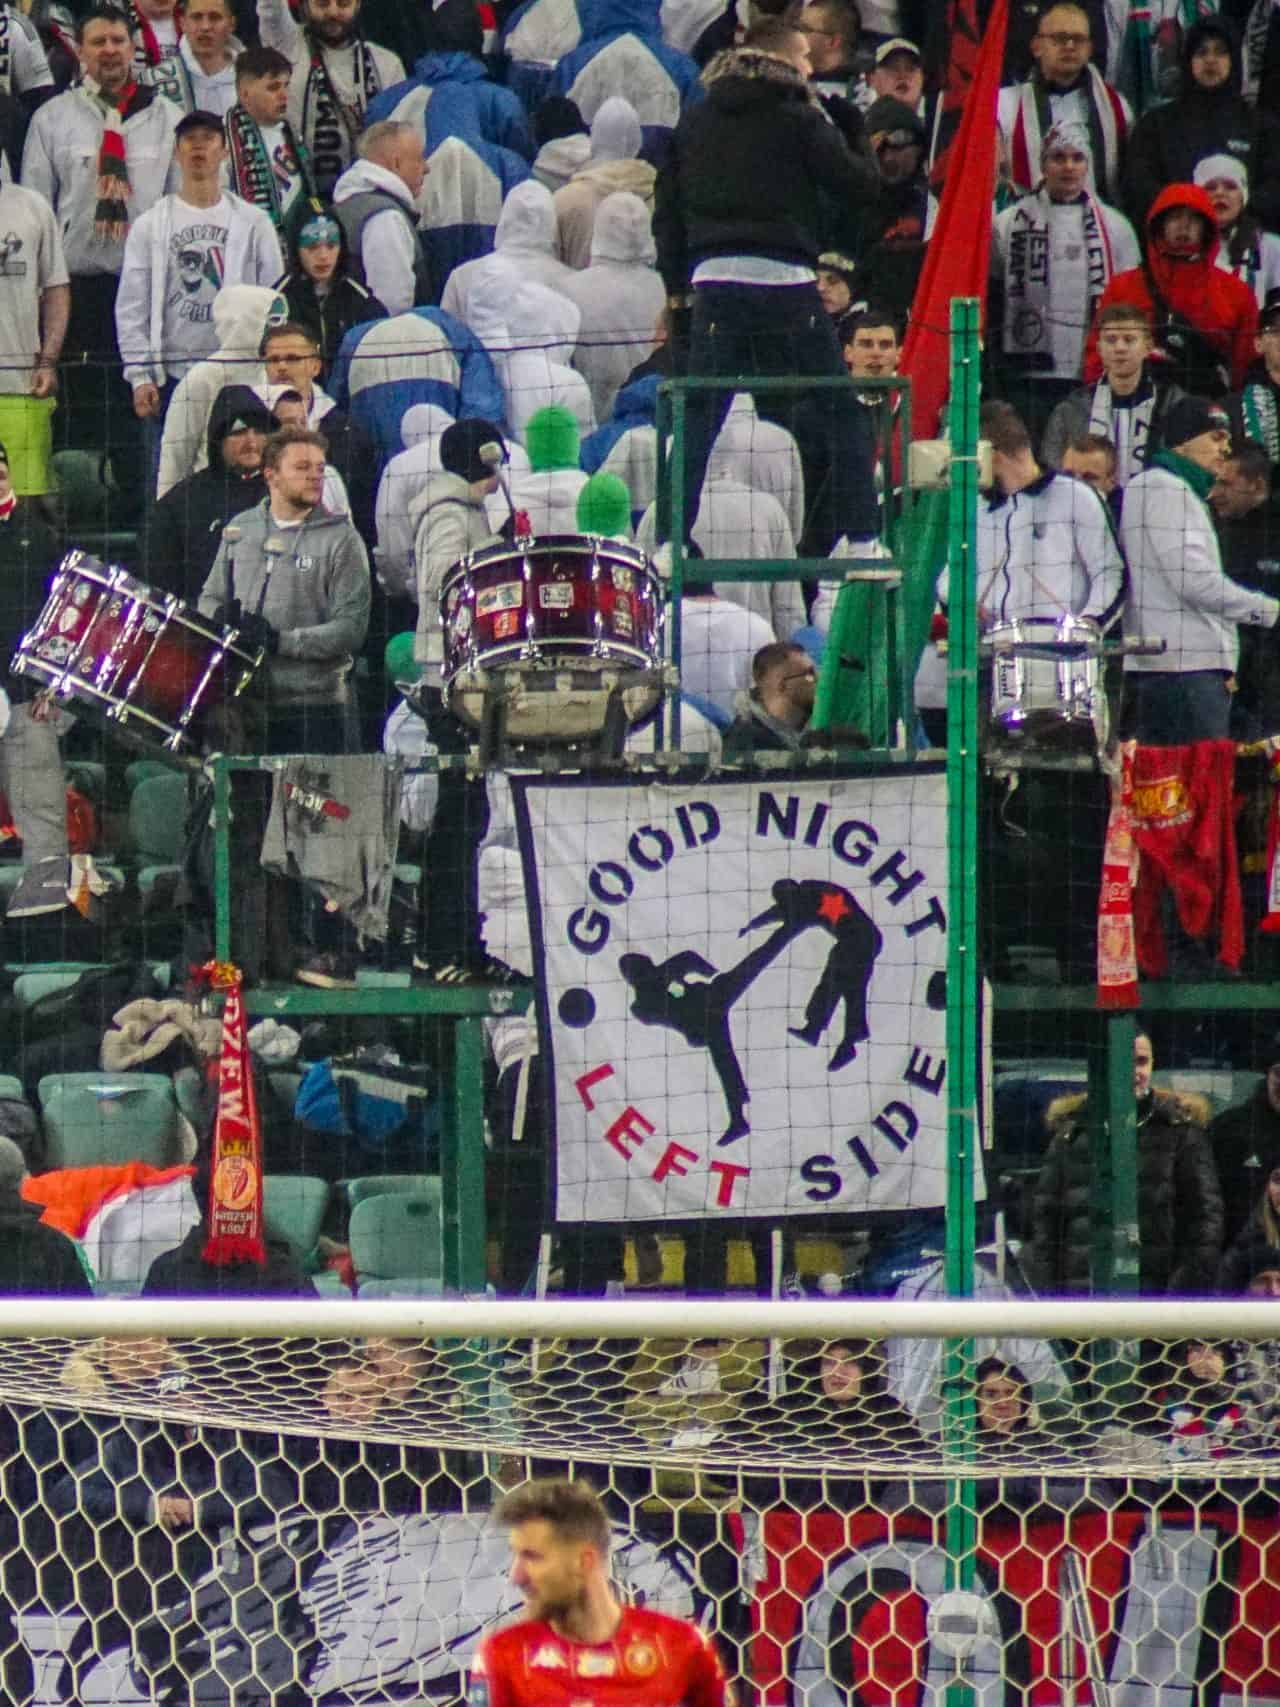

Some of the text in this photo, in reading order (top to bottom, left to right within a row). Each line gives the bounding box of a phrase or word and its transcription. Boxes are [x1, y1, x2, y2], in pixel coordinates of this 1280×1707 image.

[567, 791, 946, 955] GOOD NIGHT
[575, 1046, 946, 1207] LEFT SIDE
